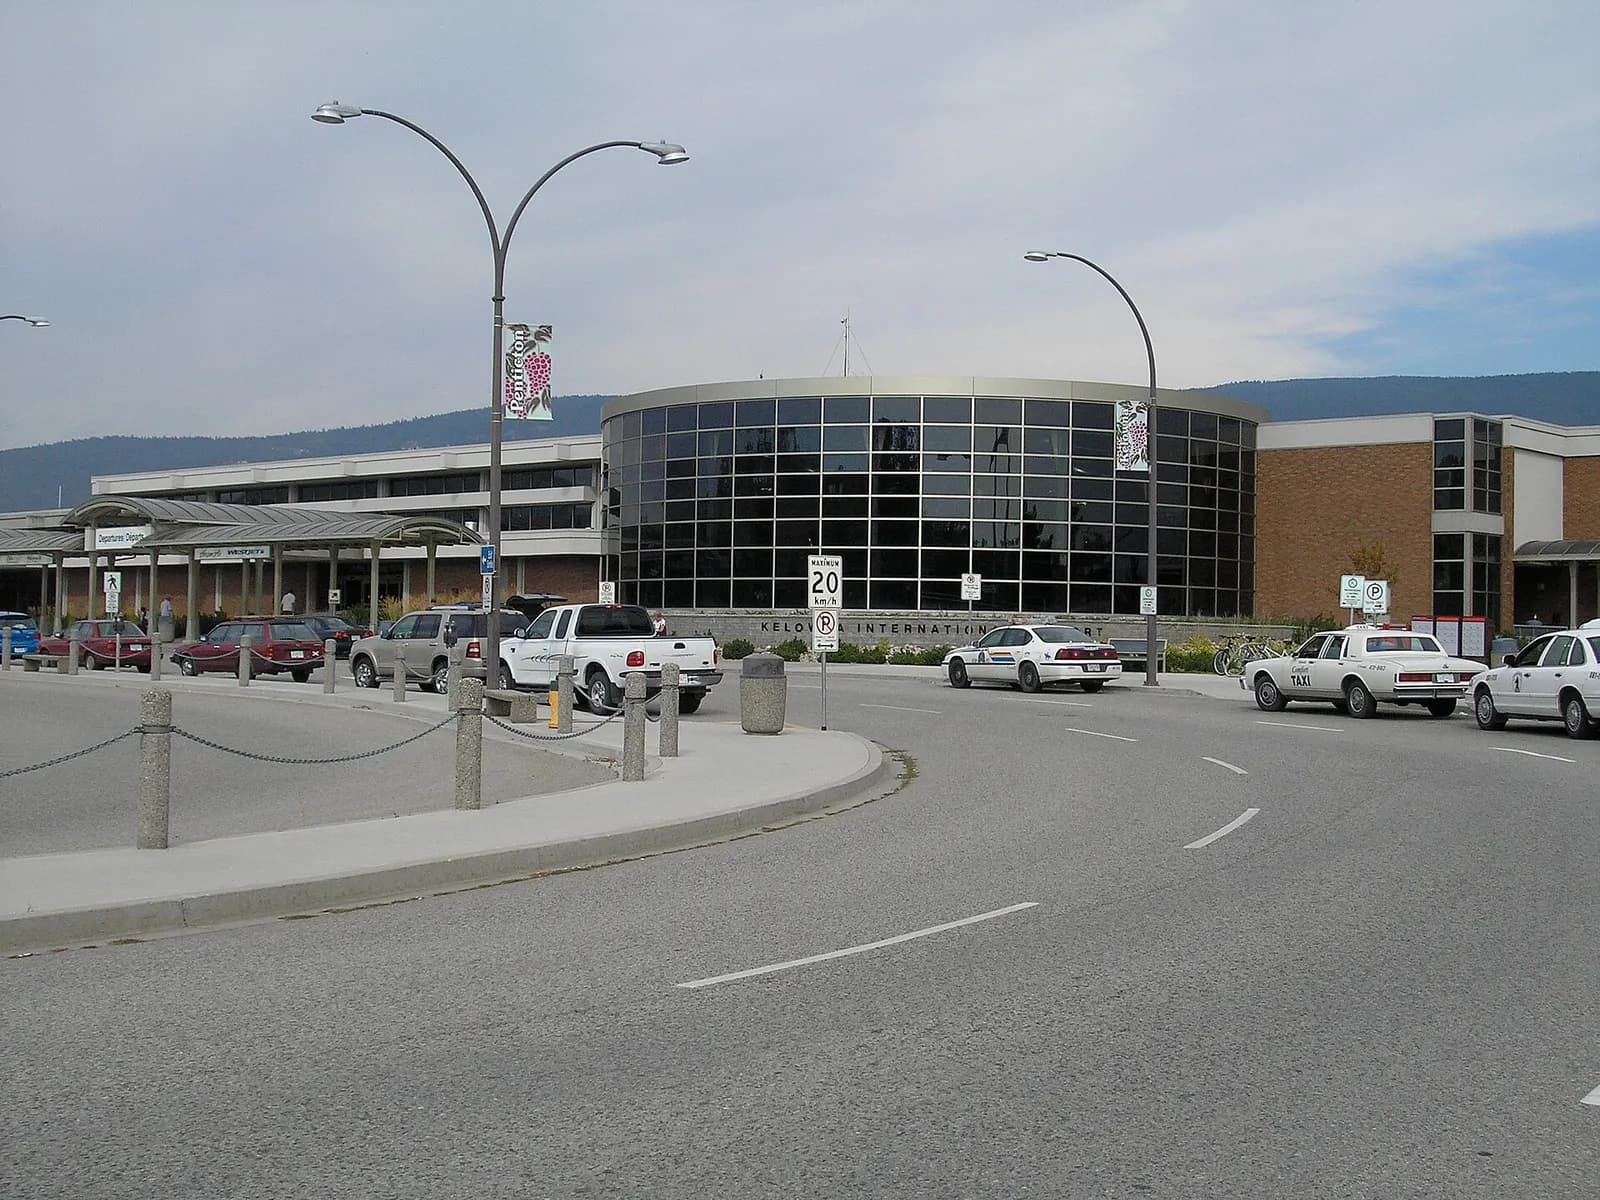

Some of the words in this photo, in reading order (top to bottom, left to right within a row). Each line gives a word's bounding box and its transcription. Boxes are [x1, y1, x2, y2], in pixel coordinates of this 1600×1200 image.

[511, 330, 524, 411] Penticton
[1119, 408, 1129, 463] Kelowna
[812, 571, 838, 593] 20
[814, 597, 837, 606] km/h
[761, 622, 845, 633] KELOA
[857, 624, 998, 636] INTERNATION
[1291, 675, 1311, 686] TAXI
